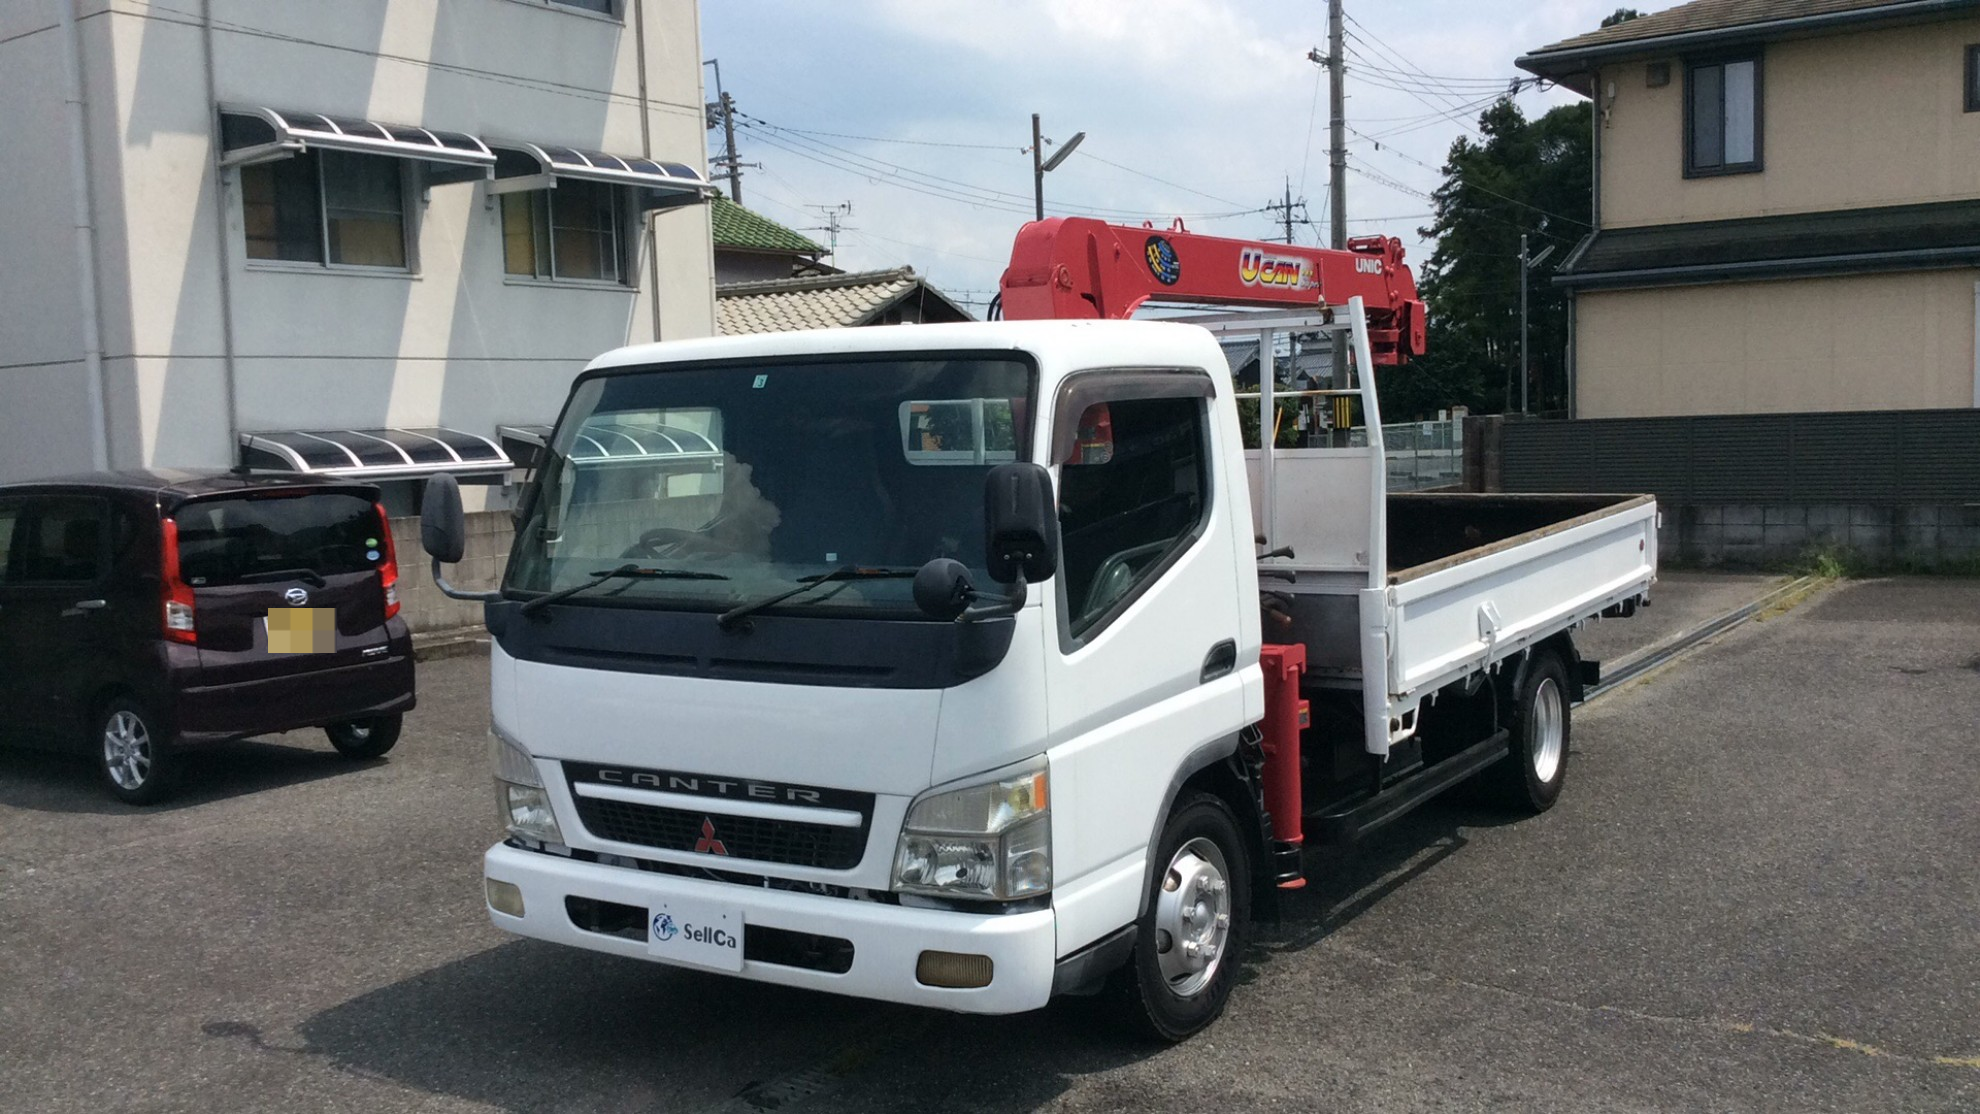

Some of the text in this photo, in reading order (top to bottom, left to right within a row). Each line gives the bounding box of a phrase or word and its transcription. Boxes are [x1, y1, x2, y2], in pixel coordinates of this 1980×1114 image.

[1241, 252, 1301, 286] UCAN
[1355, 257, 1382, 275] UNIC
[598, 770, 821, 803] CANTER
[683, 923, 737, 949] SellCa
